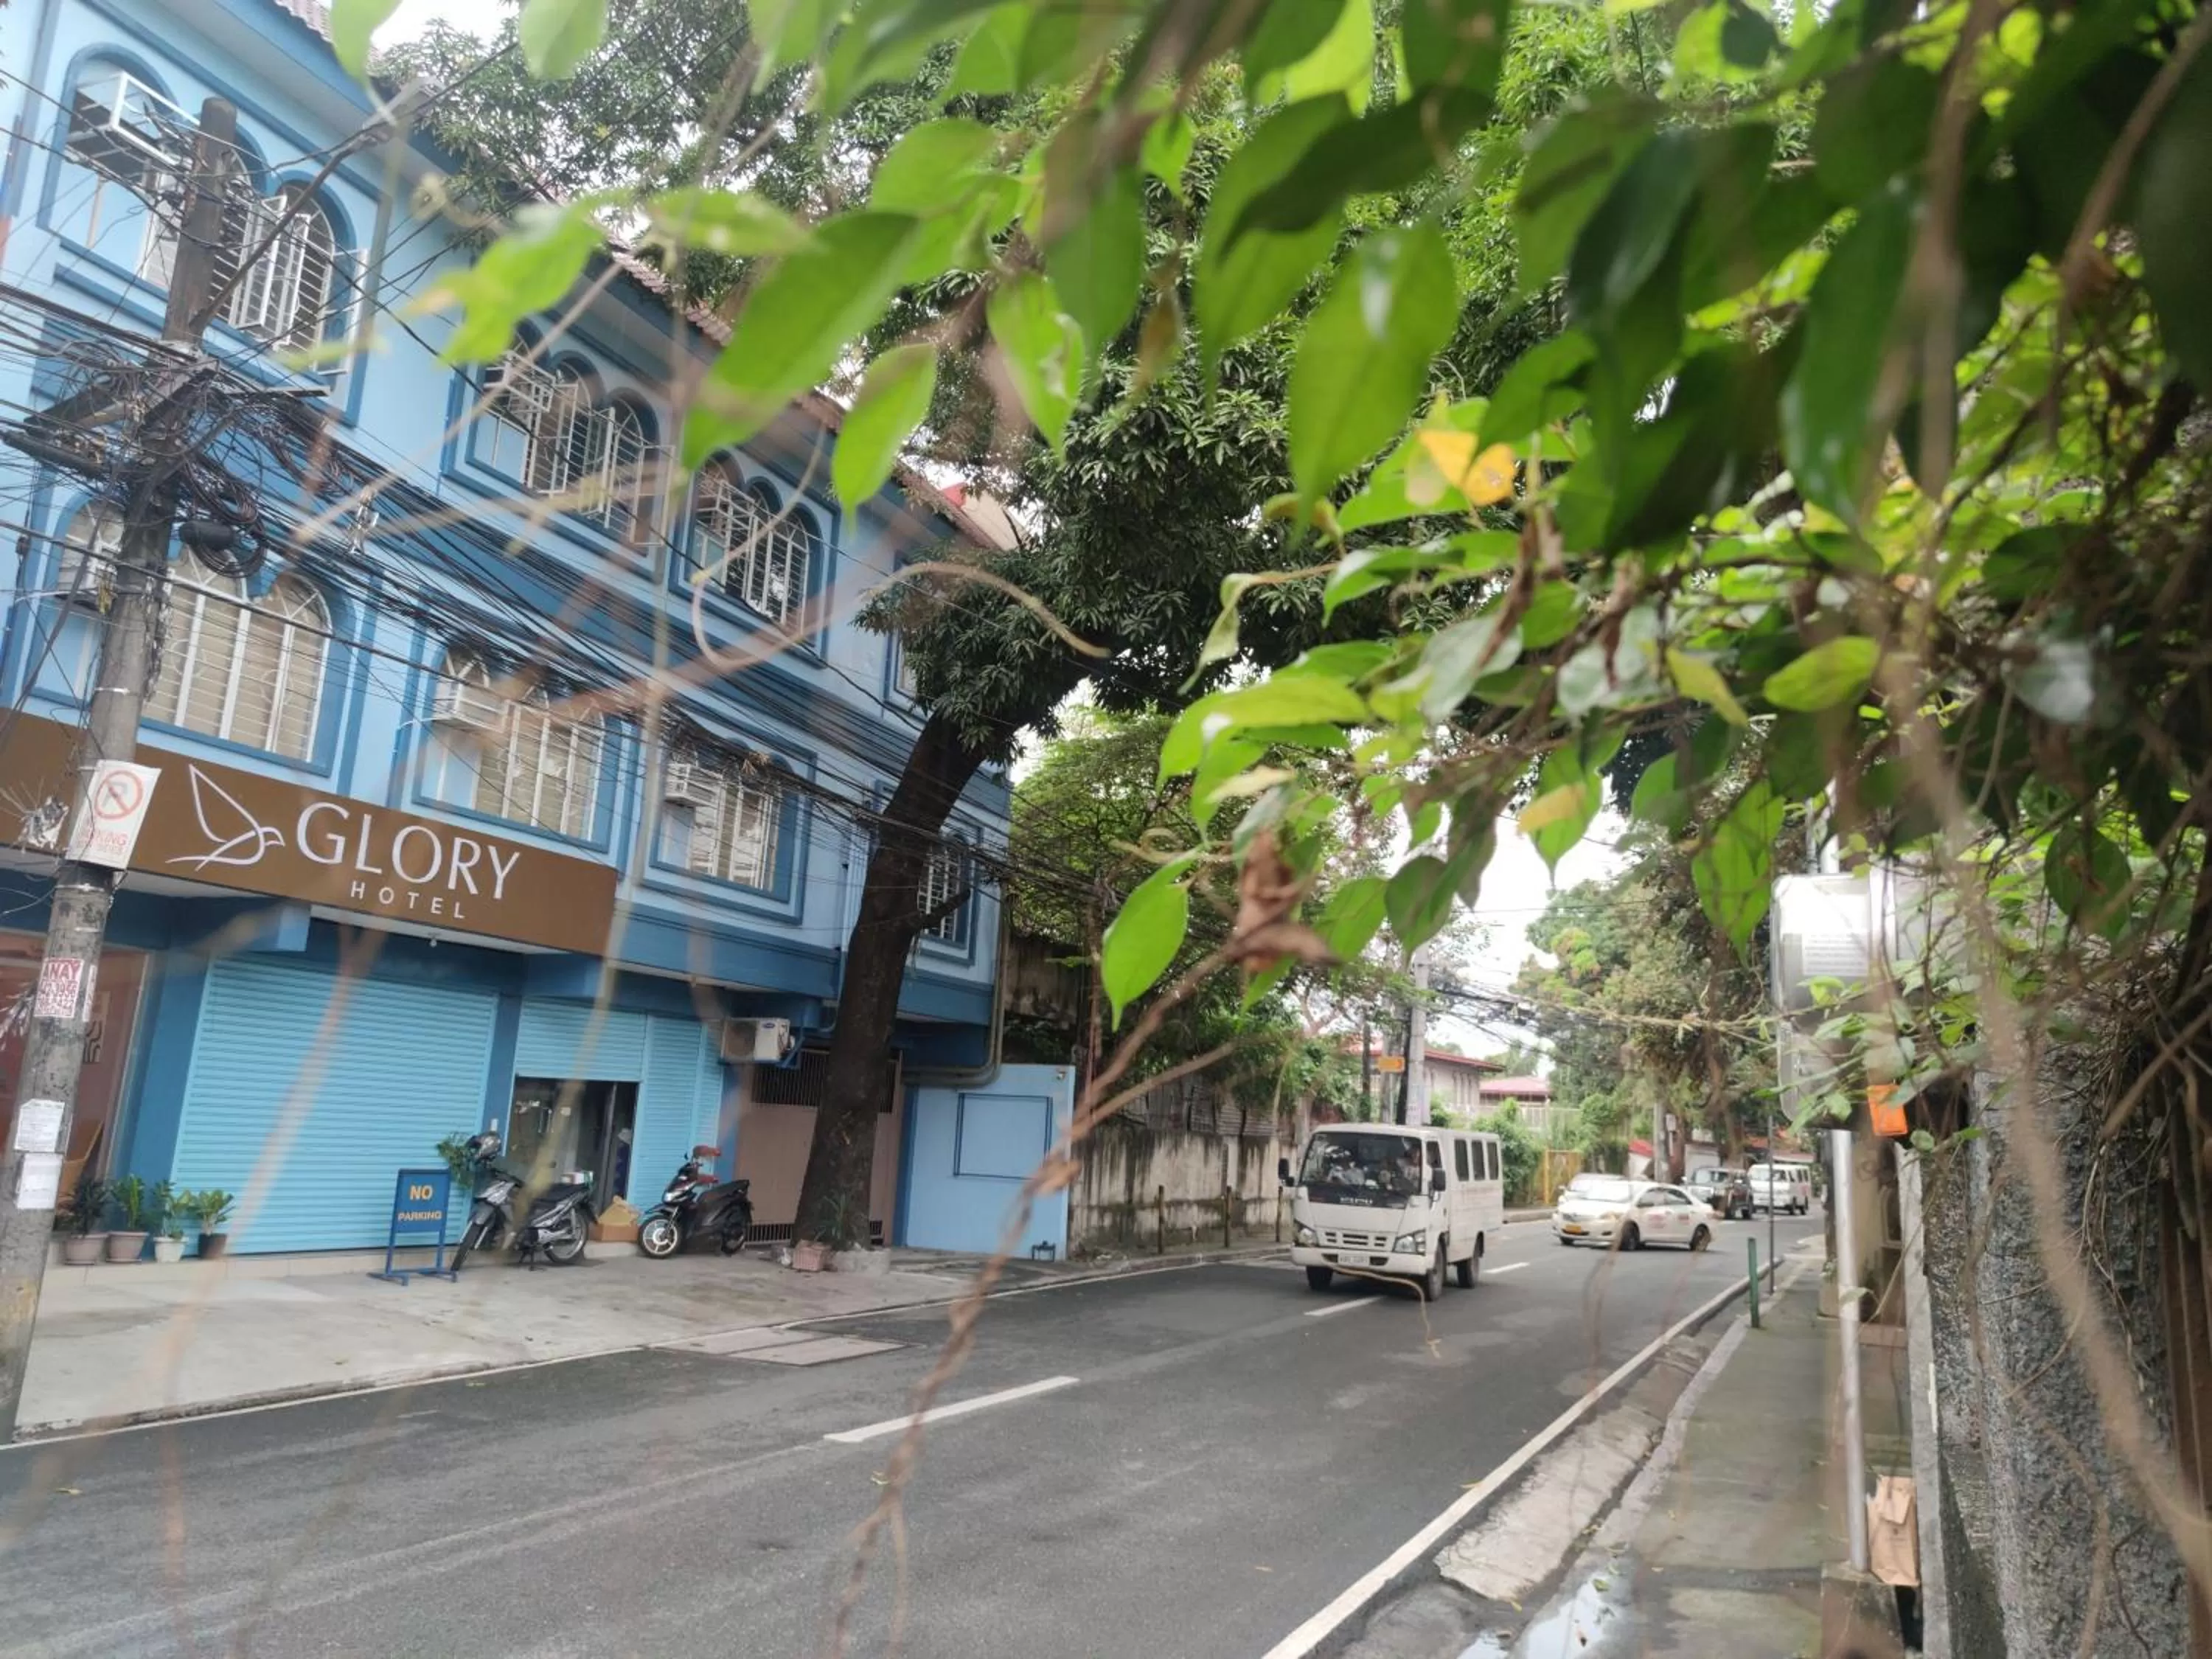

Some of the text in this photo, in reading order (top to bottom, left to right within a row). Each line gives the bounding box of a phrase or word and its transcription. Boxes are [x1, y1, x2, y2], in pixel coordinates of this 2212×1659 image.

[296, 801, 521, 900] GLORY
[350, 880, 465, 919] HOTEL
[410, 1185, 433, 1200] NO
[397, 1210, 442, 1221] PARKING
